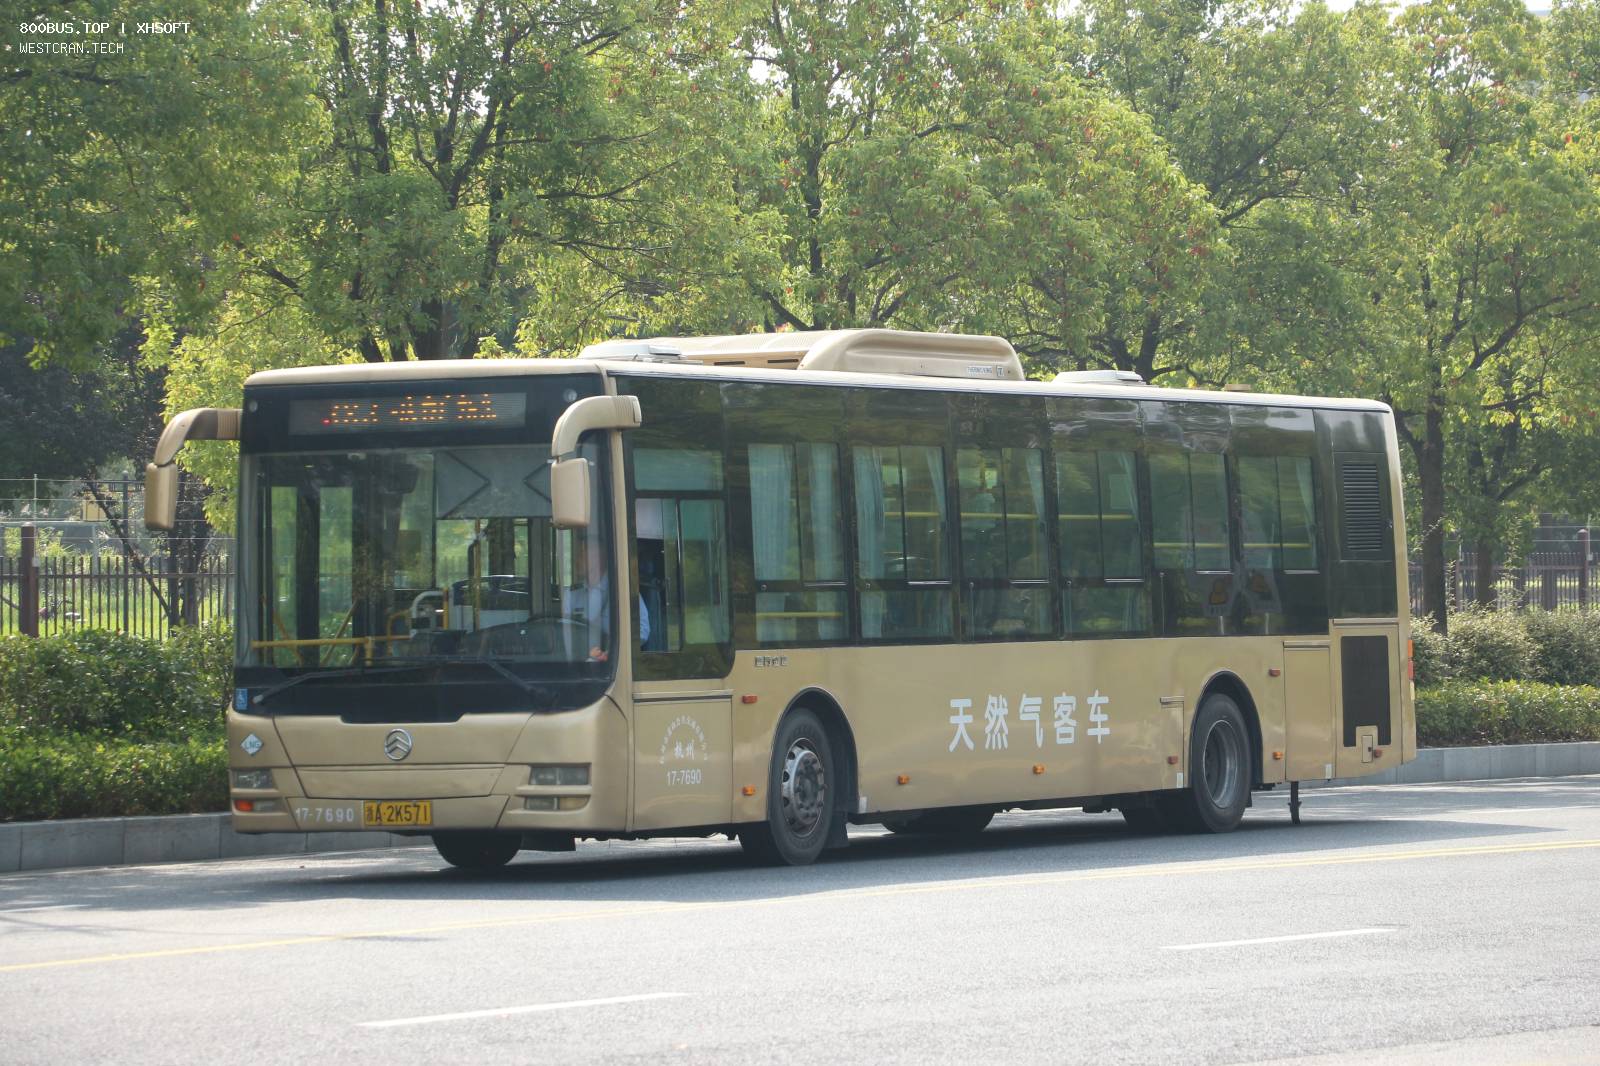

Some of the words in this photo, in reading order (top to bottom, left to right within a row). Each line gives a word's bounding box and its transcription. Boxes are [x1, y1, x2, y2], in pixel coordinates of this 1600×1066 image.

[949, 689, 1110, 752] 天然气客车
[667, 768, 702, 786] 17-7690
[295, 807, 354, 822] 17-7690
